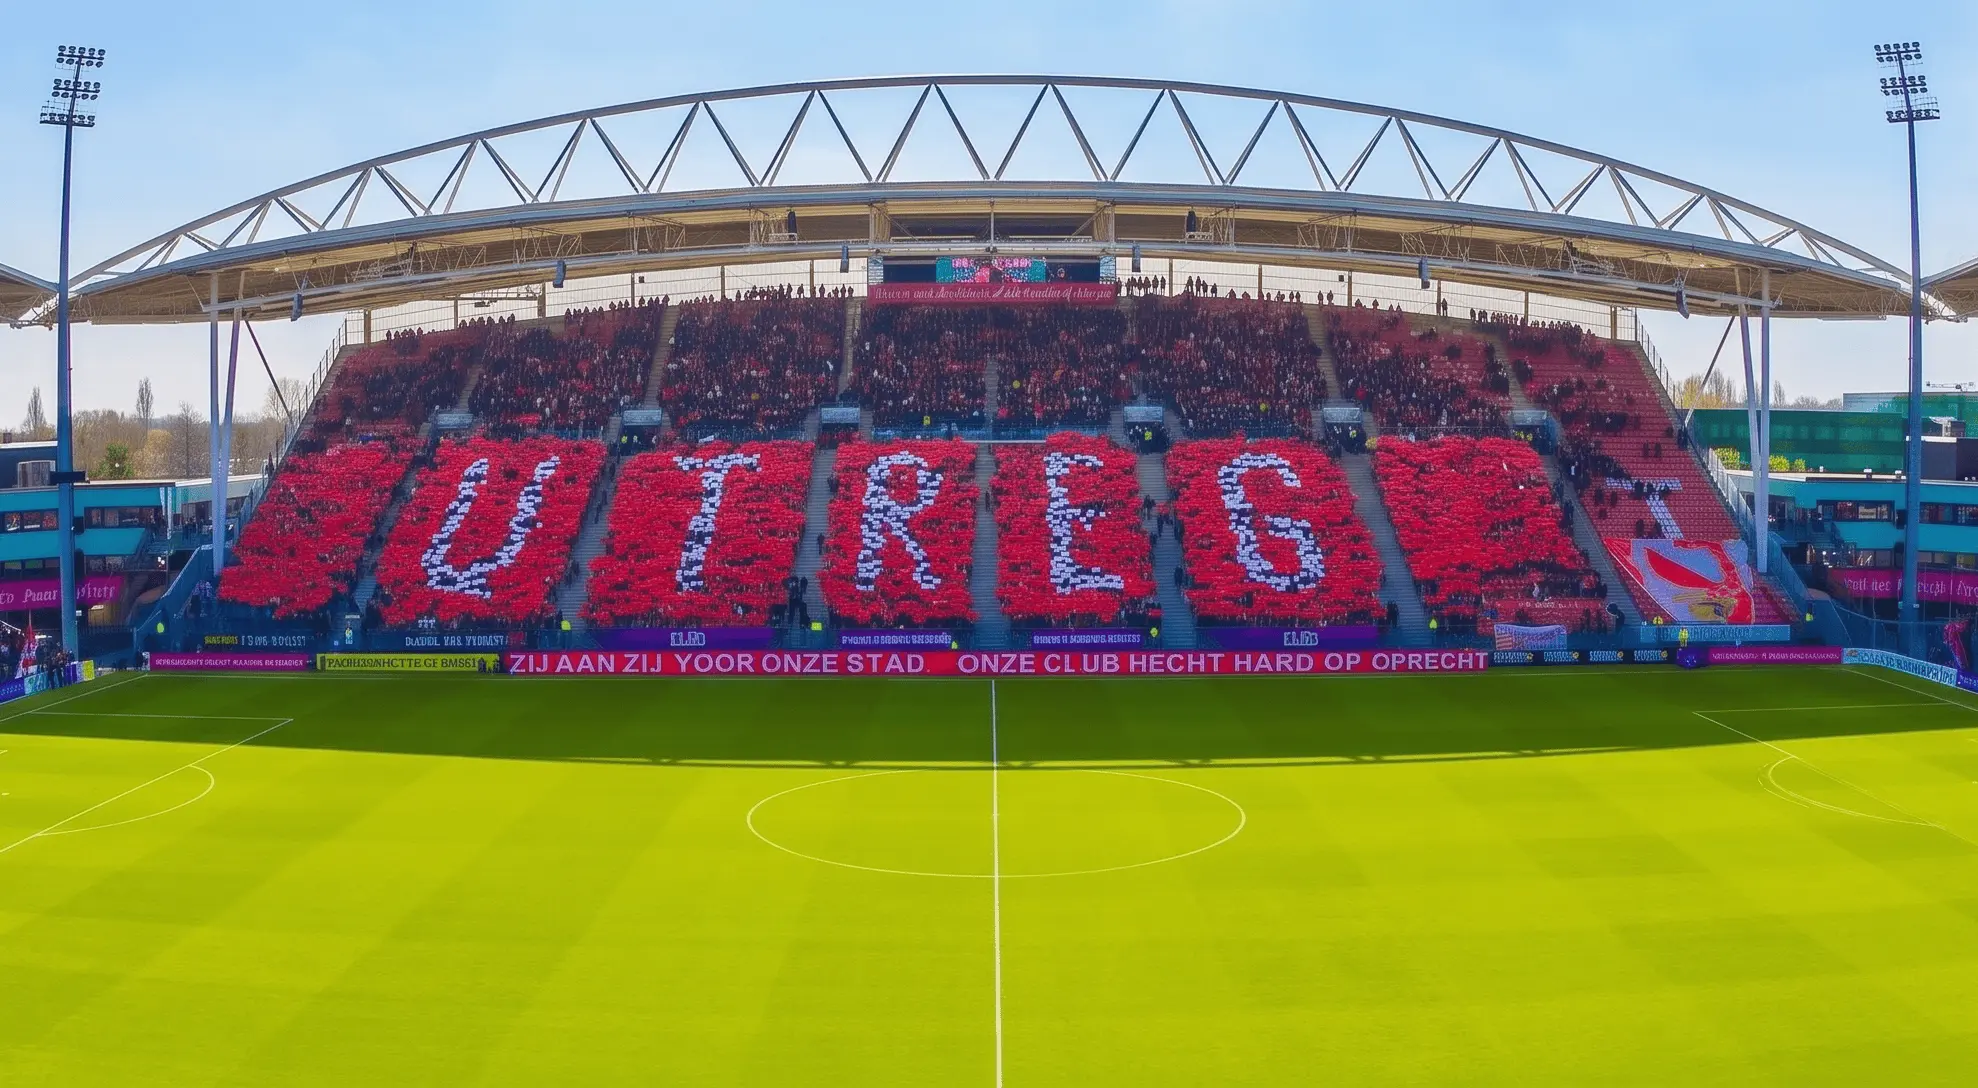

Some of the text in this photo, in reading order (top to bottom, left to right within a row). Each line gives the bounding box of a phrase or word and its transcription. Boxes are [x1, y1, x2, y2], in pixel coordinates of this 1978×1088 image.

[509, 654, 549, 674] ZIJ
[554, 654, 615, 674] AAN
[622, 654, 662, 674] ZIJ
[761, 654, 839, 674] ONZE
[957, 654, 1036, 674] ONZE
[1044, 654, 1120, 674] CLUB
[1129, 654, 1225, 673] HECHT
[1234, 654, 1314, 673] HARD
[1324, 653, 1362, 672] OP
[1371, 652, 1488, 672] OPRECHT
